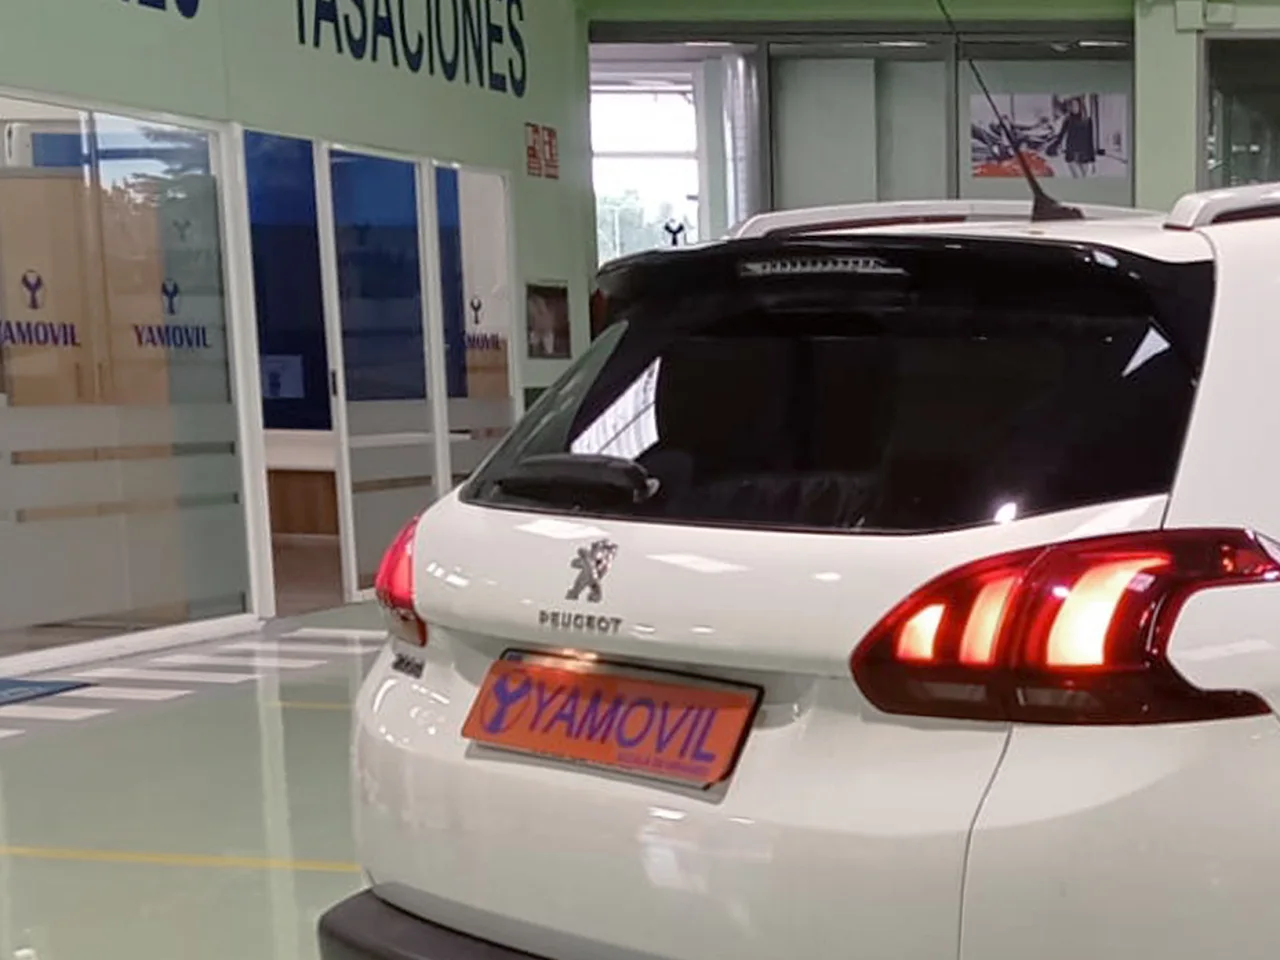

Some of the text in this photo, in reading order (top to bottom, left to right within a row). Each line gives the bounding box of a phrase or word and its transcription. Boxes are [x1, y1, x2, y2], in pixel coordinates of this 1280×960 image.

[0, 320, 81, 346] AMOVIL
[133, 324, 212, 348] YAMOVIL
[539, 610, 622, 633] PEUGEOT
[529, 679, 718, 763] YAMOVIL
